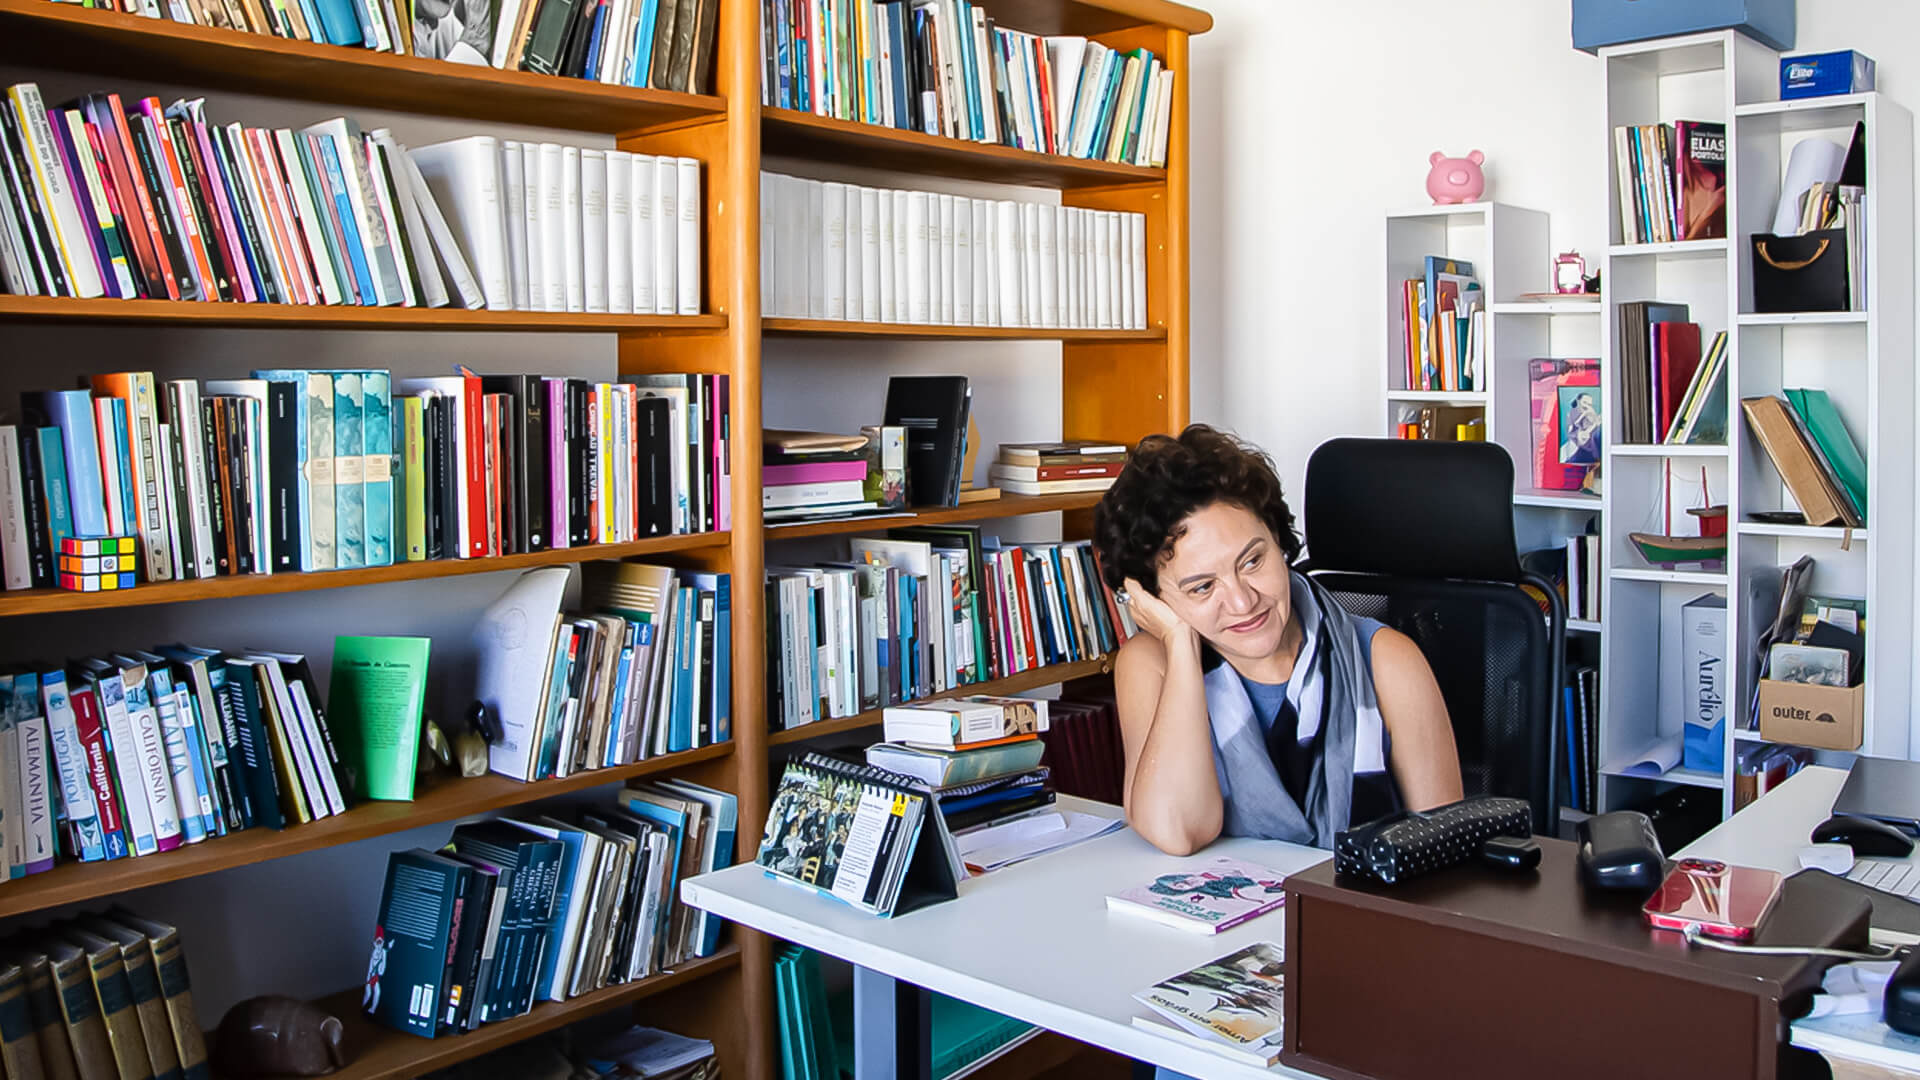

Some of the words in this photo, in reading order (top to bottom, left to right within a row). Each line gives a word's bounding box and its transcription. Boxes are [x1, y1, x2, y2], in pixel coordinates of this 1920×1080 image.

[1691, 137, 1725, 153] ELIAS
[1698, 650, 1723, 721] Aurélio
[1772, 706, 1811, 721] outer
[218, 692, 239, 749] ALEMANHA
[26, 725, 44, 825] ALEMANHA
[53, 727, 81, 804] PORTUGAL
[89, 741, 111, 801] Califórnia
[1188, 1012, 1212, 1025] em
[1213, 1023, 1252, 1044] Amor
